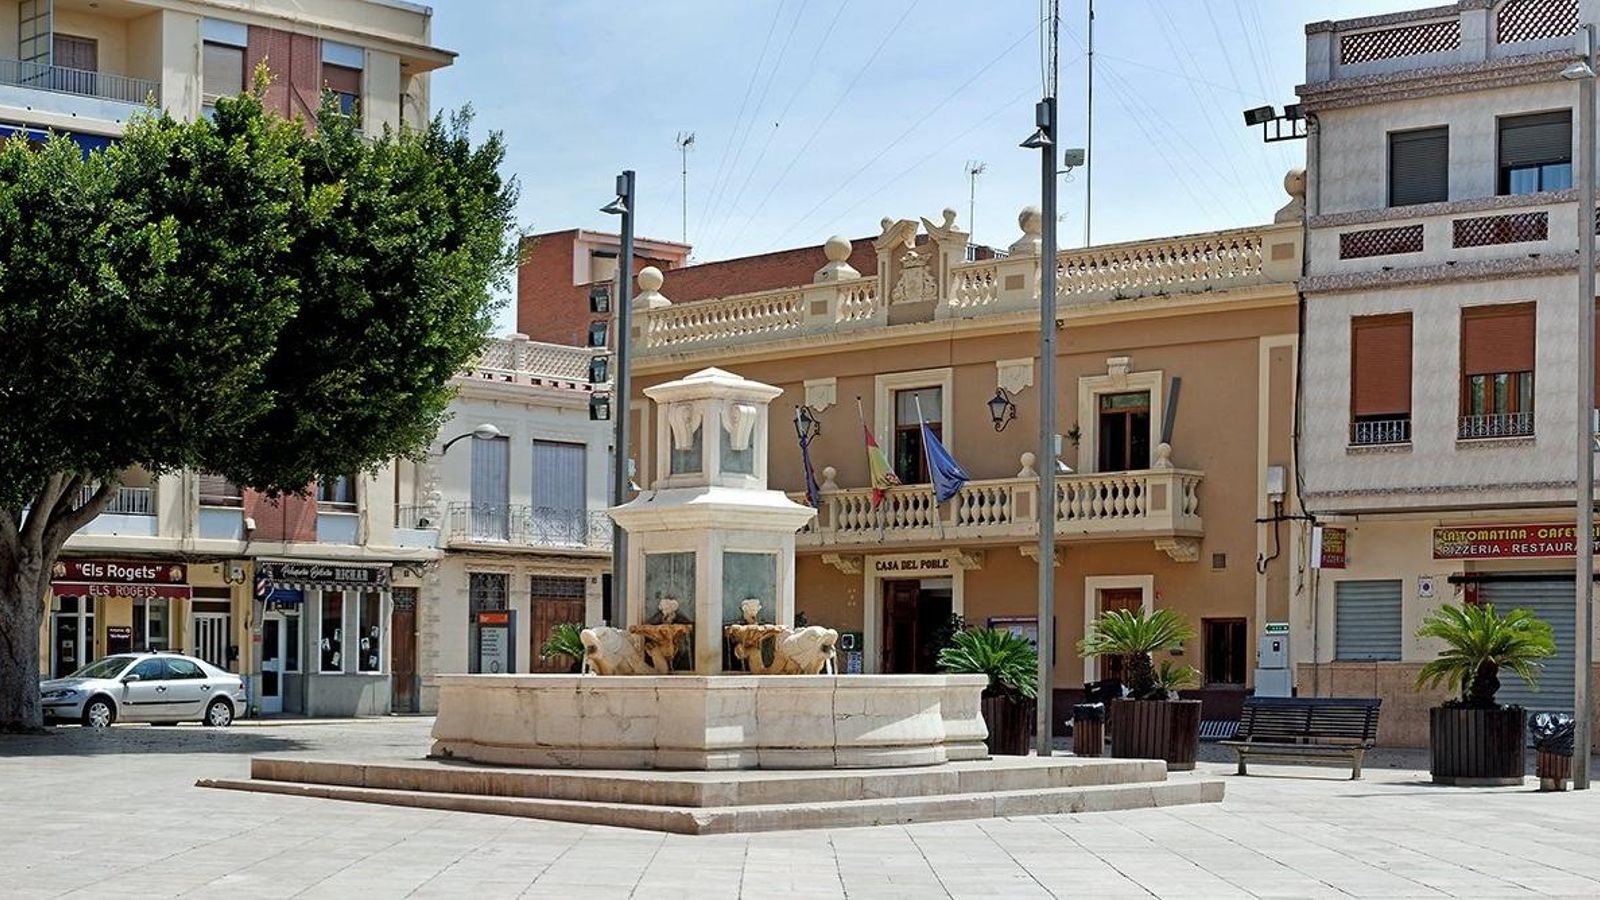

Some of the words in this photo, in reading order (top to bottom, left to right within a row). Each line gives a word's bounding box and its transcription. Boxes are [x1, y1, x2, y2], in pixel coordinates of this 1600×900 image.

[1459, 529, 1527, 541] TOMATINA
[1440, 544, 1500, 555] PIZZERIA
[875, 561, 899, 571] CASA
[901, 560, 918, 570] DEL
[920, 559, 949, 569] POBLE
[107, 564, 162, 581] Rogets"
[88, 585, 110, 596] ELS
[115, 585, 157, 597] ROGETS
